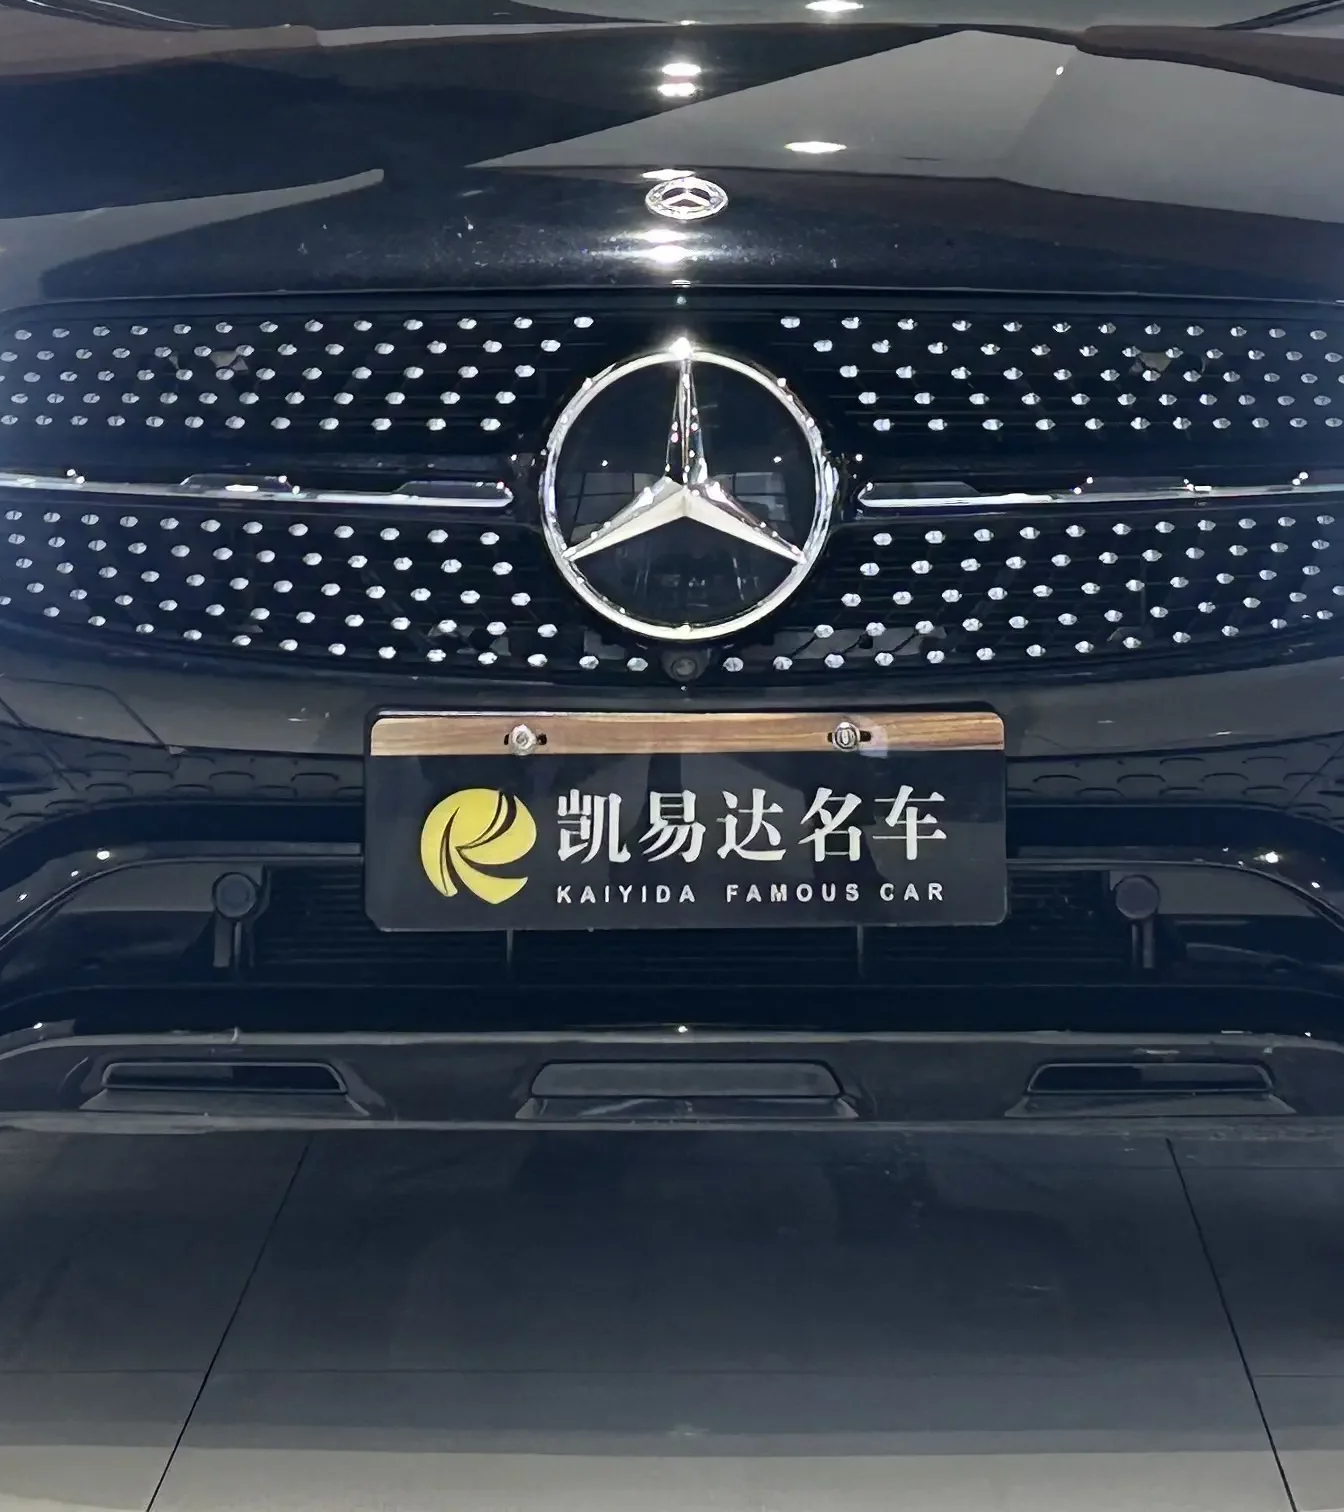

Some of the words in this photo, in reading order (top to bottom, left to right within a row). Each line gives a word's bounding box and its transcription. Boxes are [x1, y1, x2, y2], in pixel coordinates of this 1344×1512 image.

[557, 785, 948, 864] 凯易达名车
[556, 885, 696, 904] KAIYIDA
[726, 884, 860, 903] FAMOUS
[879, 883, 944, 902] CAR
